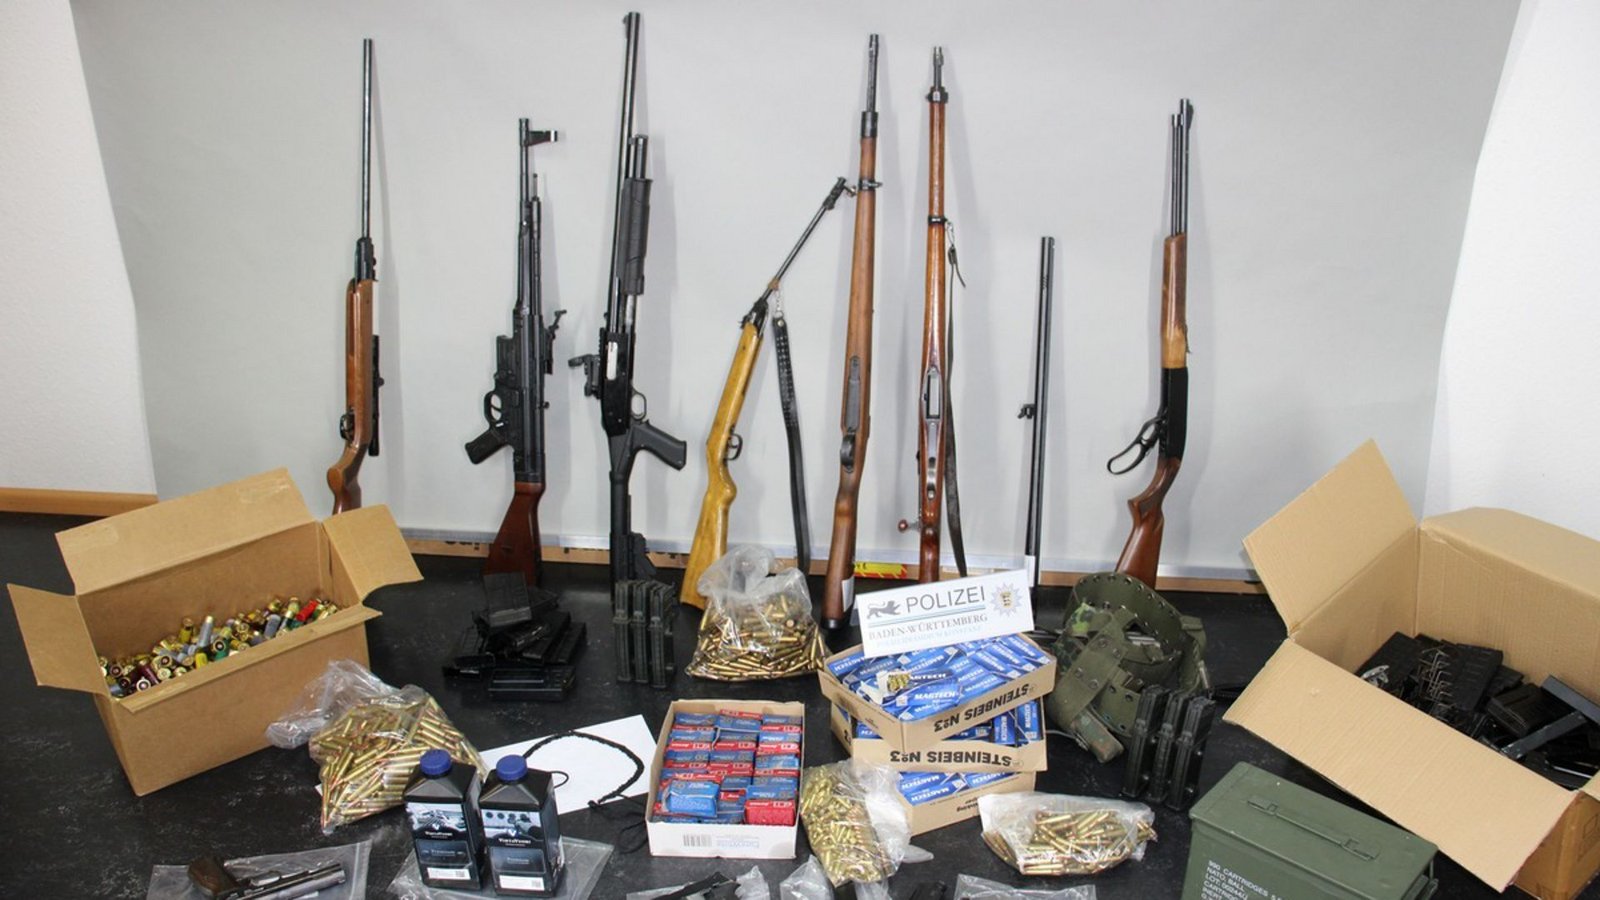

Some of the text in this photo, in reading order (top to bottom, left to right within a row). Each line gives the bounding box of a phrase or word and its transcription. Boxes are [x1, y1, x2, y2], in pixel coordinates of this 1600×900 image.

[905, 586, 986, 613] POLIZEI
[868, 613, 988, 641] BADEN-WÜRTTEMBERG
[963, 683, 1030, 720] STEINBEIS
[926, 751, 1013, 767] STEINBEIS
